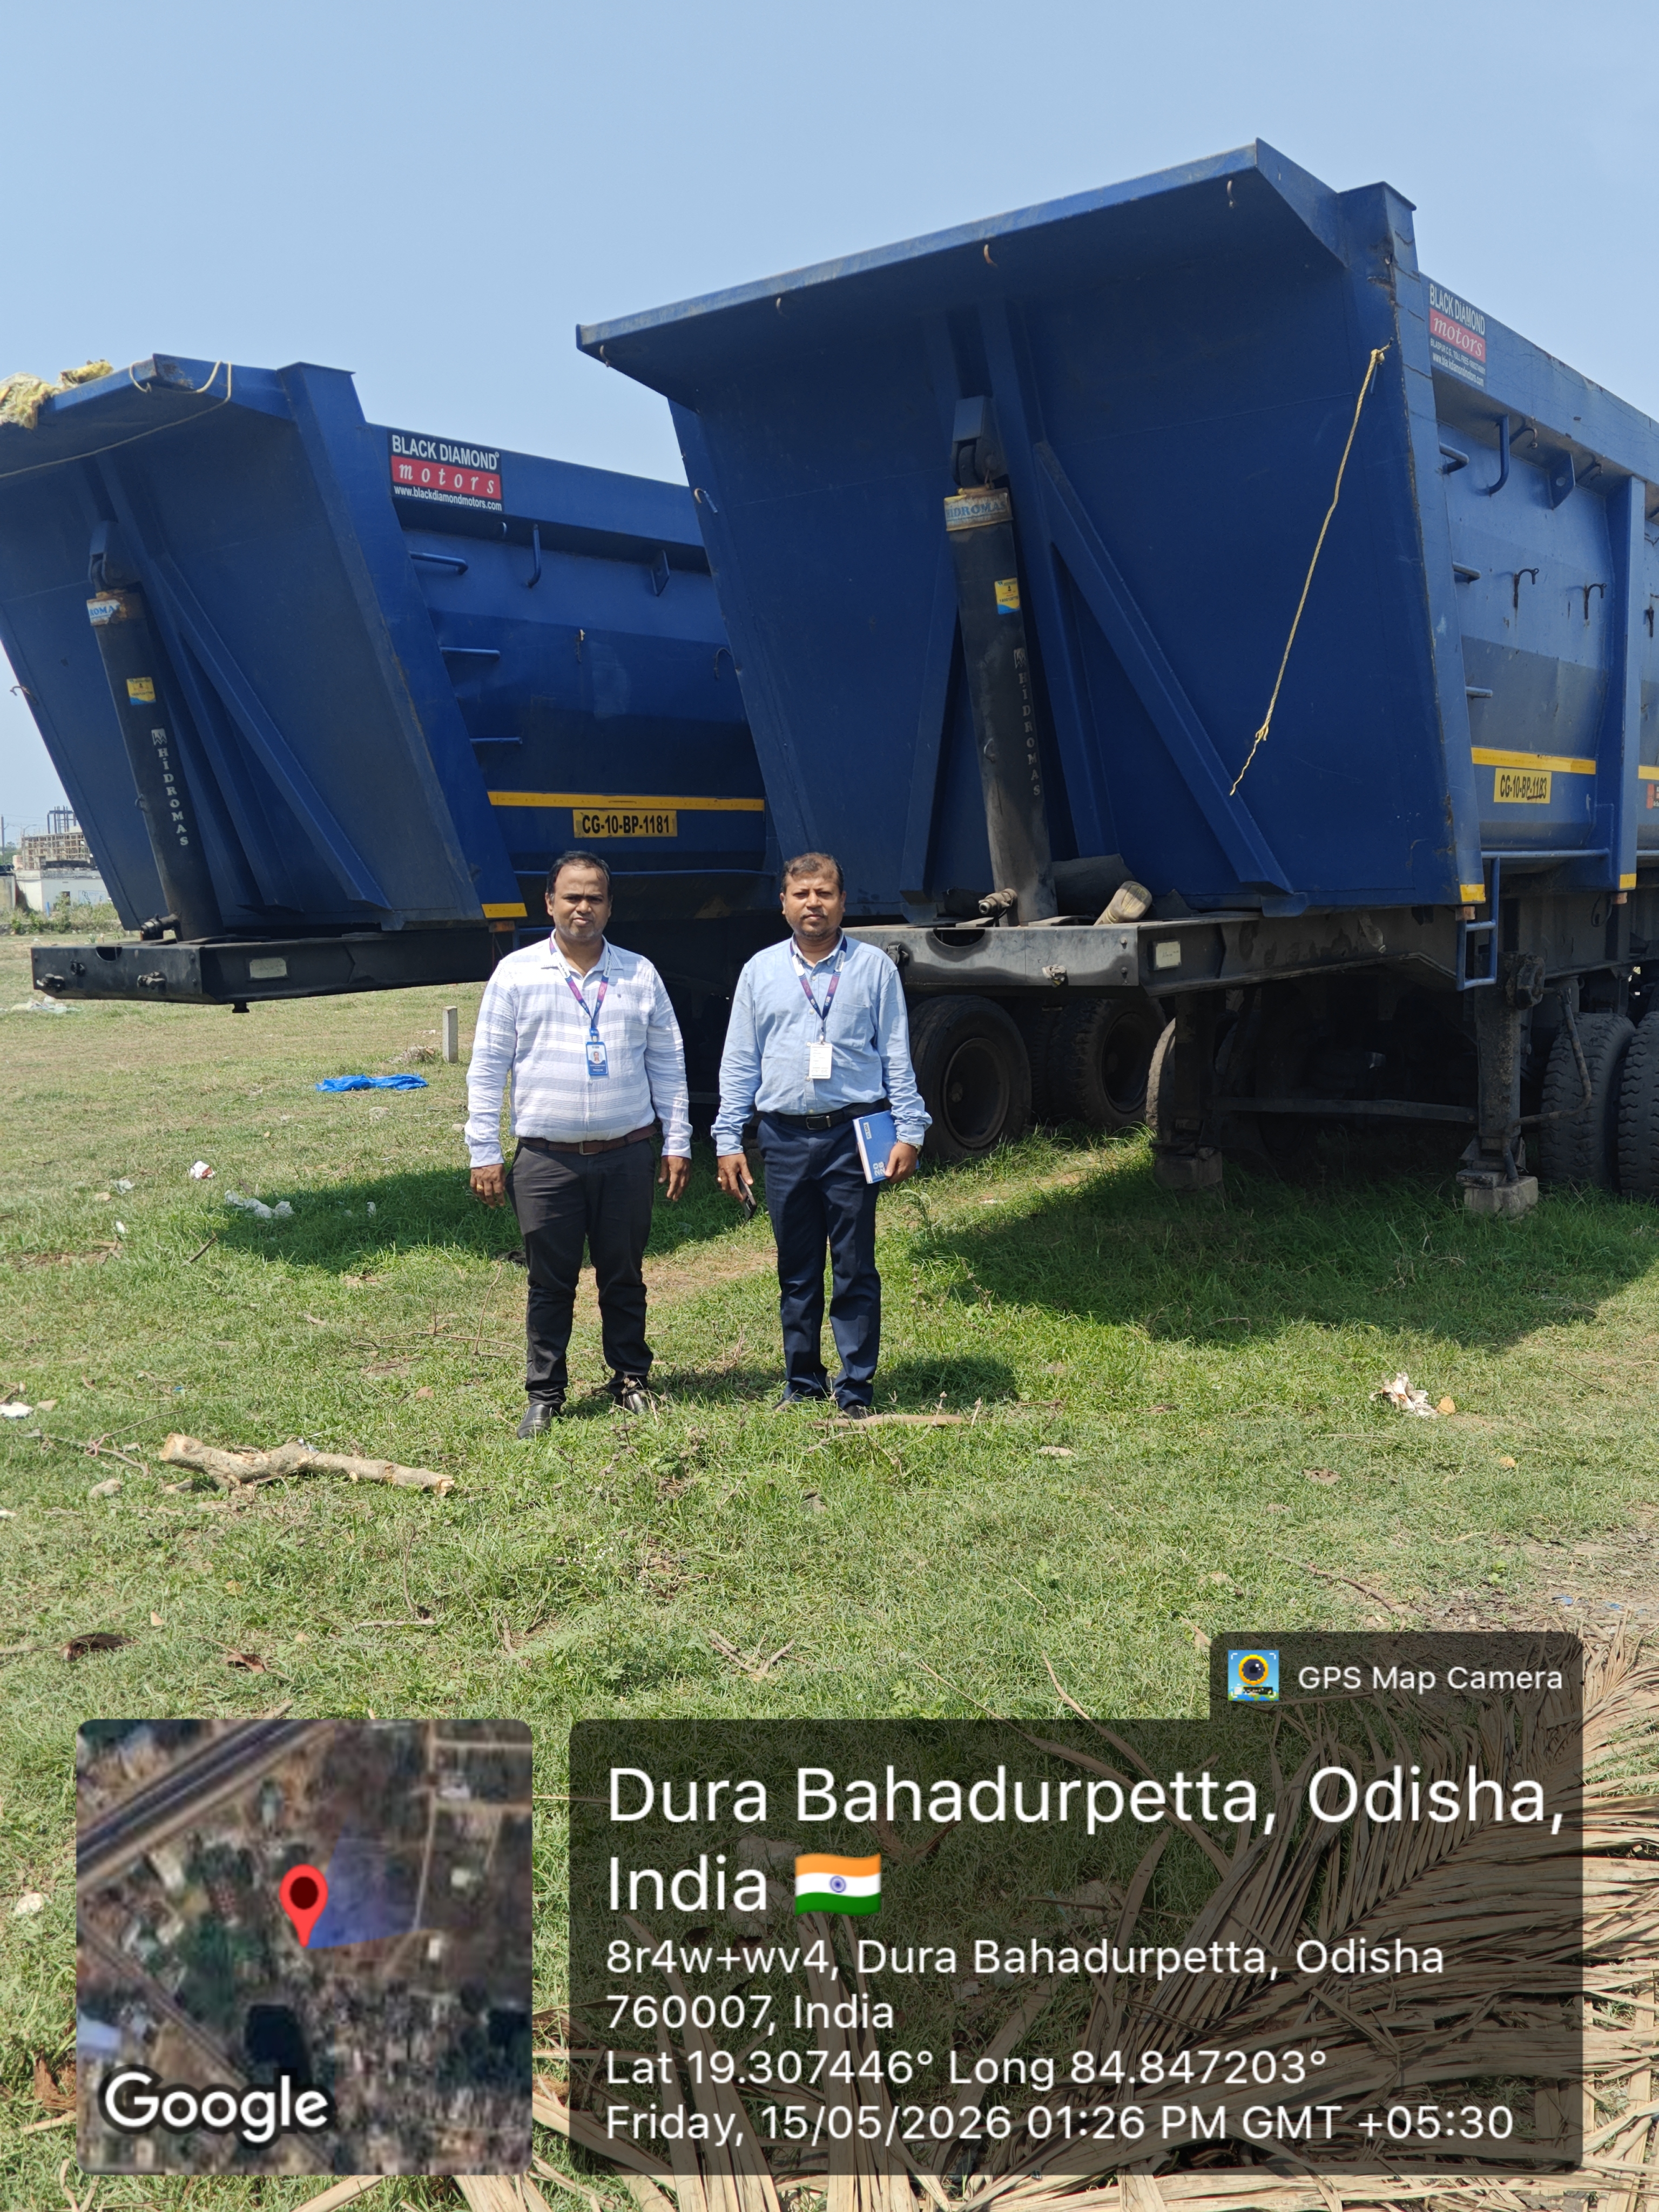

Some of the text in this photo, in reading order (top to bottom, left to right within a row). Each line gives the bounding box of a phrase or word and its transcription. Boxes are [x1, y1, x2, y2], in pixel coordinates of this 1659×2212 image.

[1429, 283, 1486, 336] BLACK DIAMOND
[1433, 318, 1483, 357] motors
[392, 434, 437, 460] BLACK
[399, 463, 495, 495] motors
[393, 485, 502, 512] www.blackdiamondmotors.com
[1500, 774, 1547, 799] CG-10-BP-1183
[582, 814, 670, 834] CG-10-BP-1181
